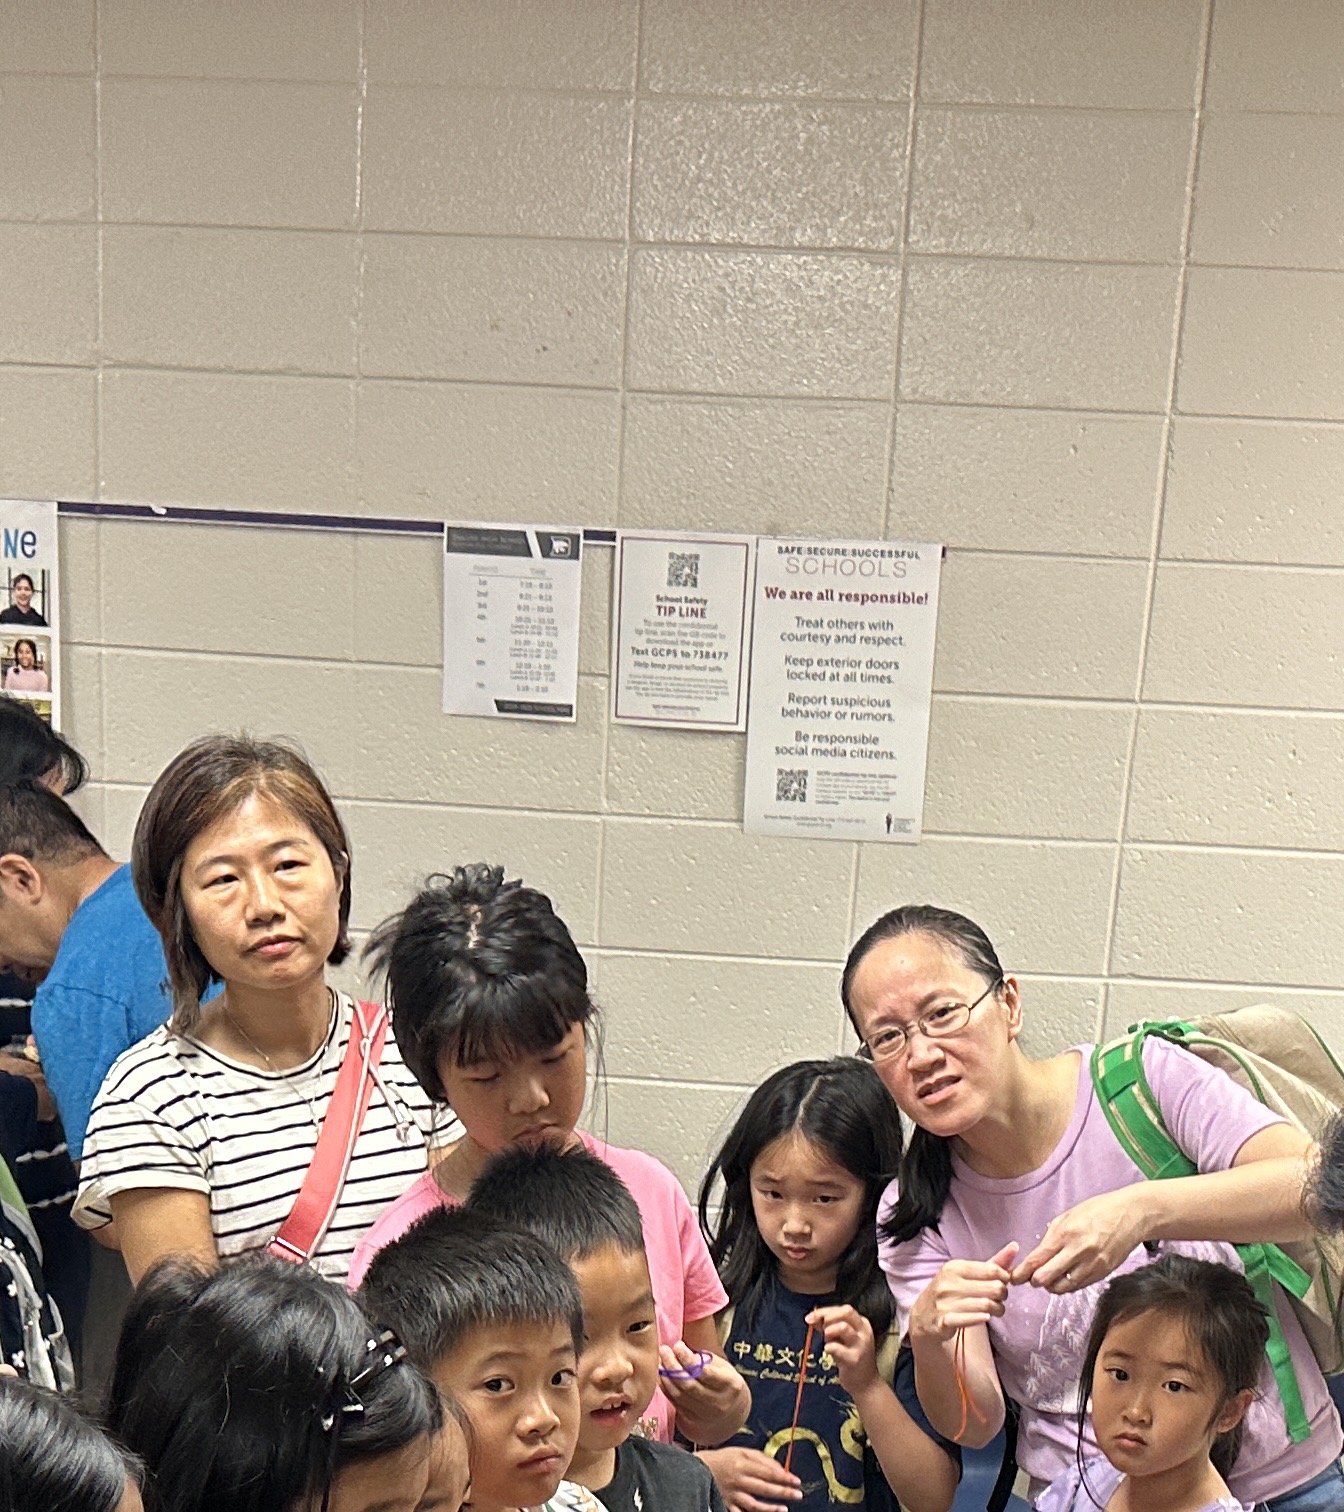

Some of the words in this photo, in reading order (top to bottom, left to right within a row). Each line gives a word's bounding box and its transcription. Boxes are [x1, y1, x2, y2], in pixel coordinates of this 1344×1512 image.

[777, 546, 803, 555] SAFE
[806, 547, 847, 556] SECURE
[851, 548, 920, 560] SUCCESSFUL
[785, 557, 907, 578] SCHOOLS
[764, 586, 787, 600] We
[790, 590, 813, 600] are
[816, 588, 834, 601] all
[838, 592, 929, 606] responsible!
[656, 605, 676, 617] TIP
[678, 606, 707, 618] LINE
[795, 616, 824, 629] Treat
[827, 617, 865, 631] others
[868, 620, 894, 631] with
[780, 631, 831, 646] courtesy
[834, 632, 856, 645] and
[859, 634, 906, 648] respect.
[784, 655, 814, 669] Keep
[816, 656, 862, 669] exterior
[865, 658, 899, 671] doors
[786, 669, 826, 682] locked
[829, 671, 840, 682] at
[843, 670, 857, 682] all
[860, 671, 894, 684] times.
[788, 692, 827, 707] Report
[830, 694, 891, 709] suspicious
[781, 706, 831, 720] behavior
[834, 709, 848, 720] or
[850, 710, 895, 723] rumors.
[795, 730, 809, 743] Be
[812, 732, 879, 747] responsible
[775, 744, 808, 756] social
[811, 745, 847, 758] media
[849, 747, 897, 761] citizens.
